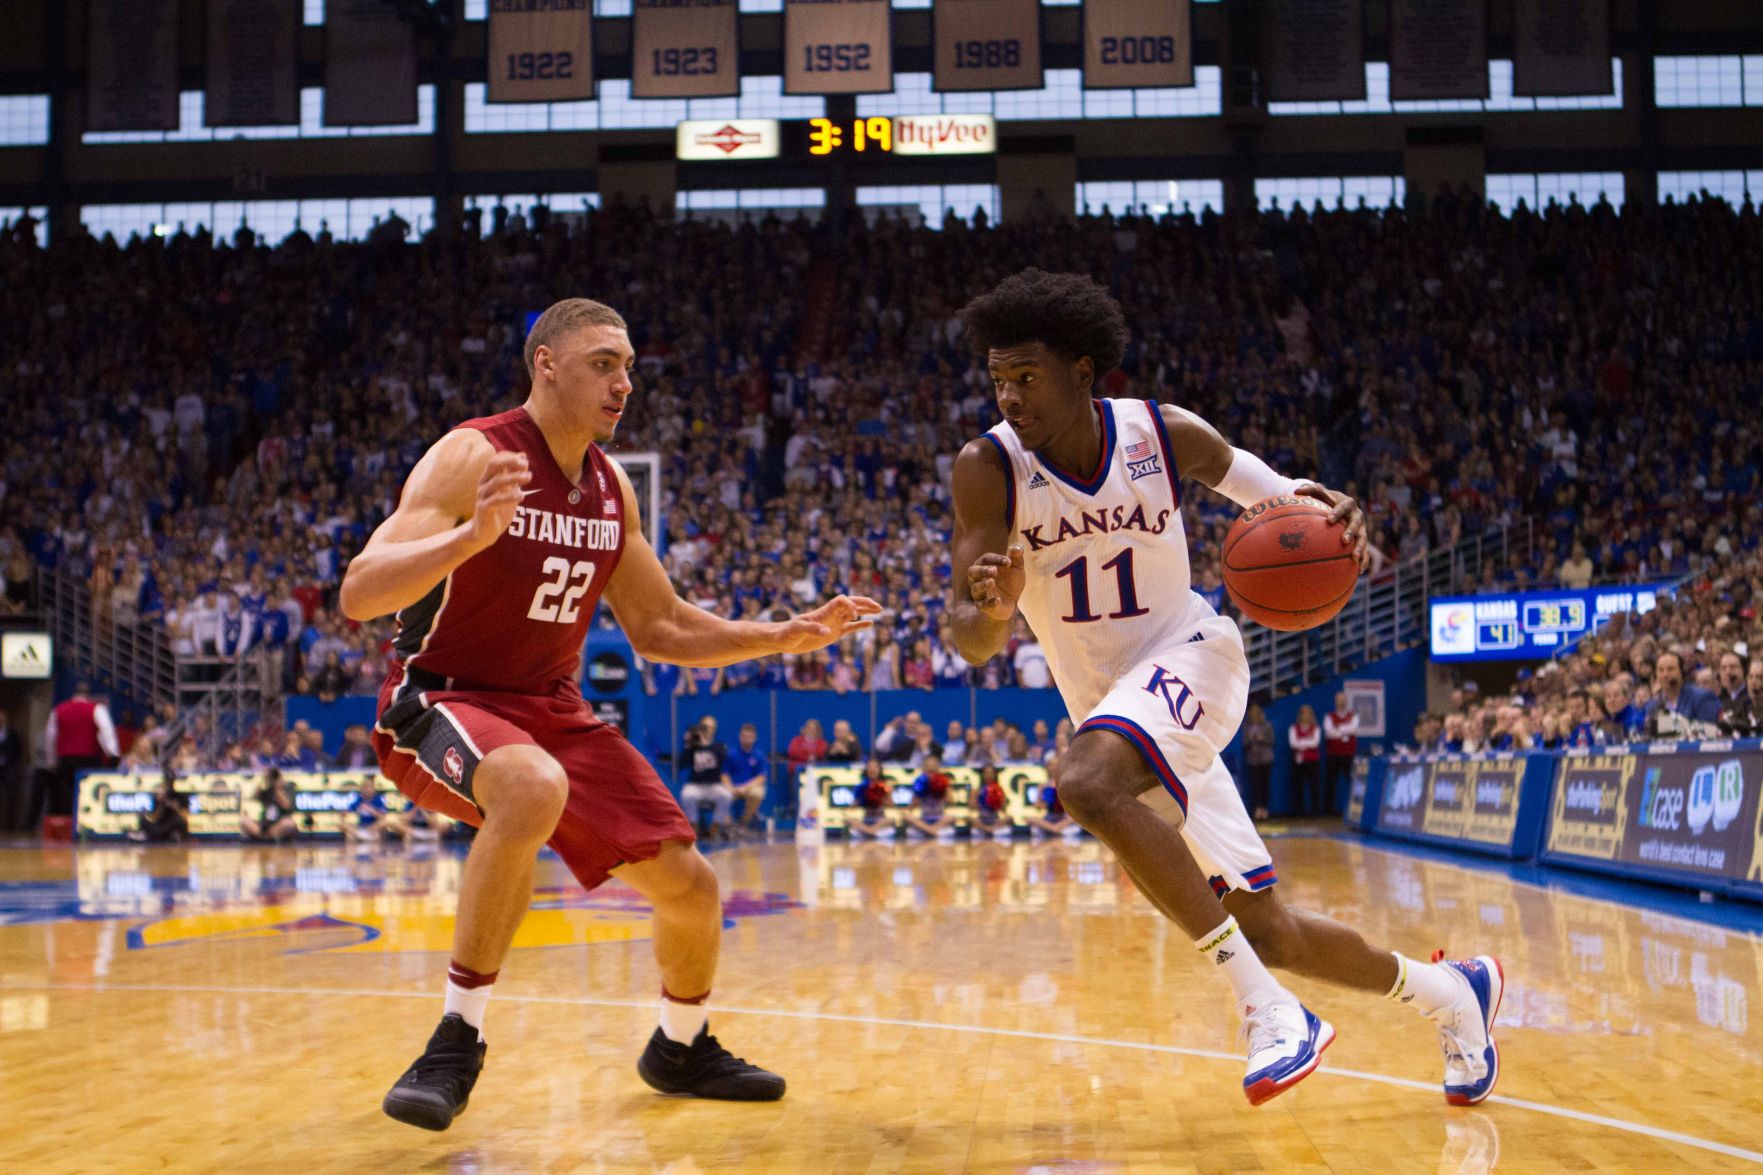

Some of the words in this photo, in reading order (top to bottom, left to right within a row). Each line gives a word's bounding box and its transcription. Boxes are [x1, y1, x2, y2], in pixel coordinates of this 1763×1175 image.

[507, 52, 574, 81] 1922
[652, 47, 718, 76] 1923
[803, 43, 871, 72] 1952
[954, 39, 1022, 69] 1988
[1101, 35, 1175, 64] 2008
[809, 117, 892, 155] 3:19
[508, 505, 621, 551] STANFORD
[1021, 503, 1170, 551] KANSAS
[526, 555, 596, 624] 22
[1055, 547, 1150, 623] 11
[1141, 663, 1205, 731] KU
